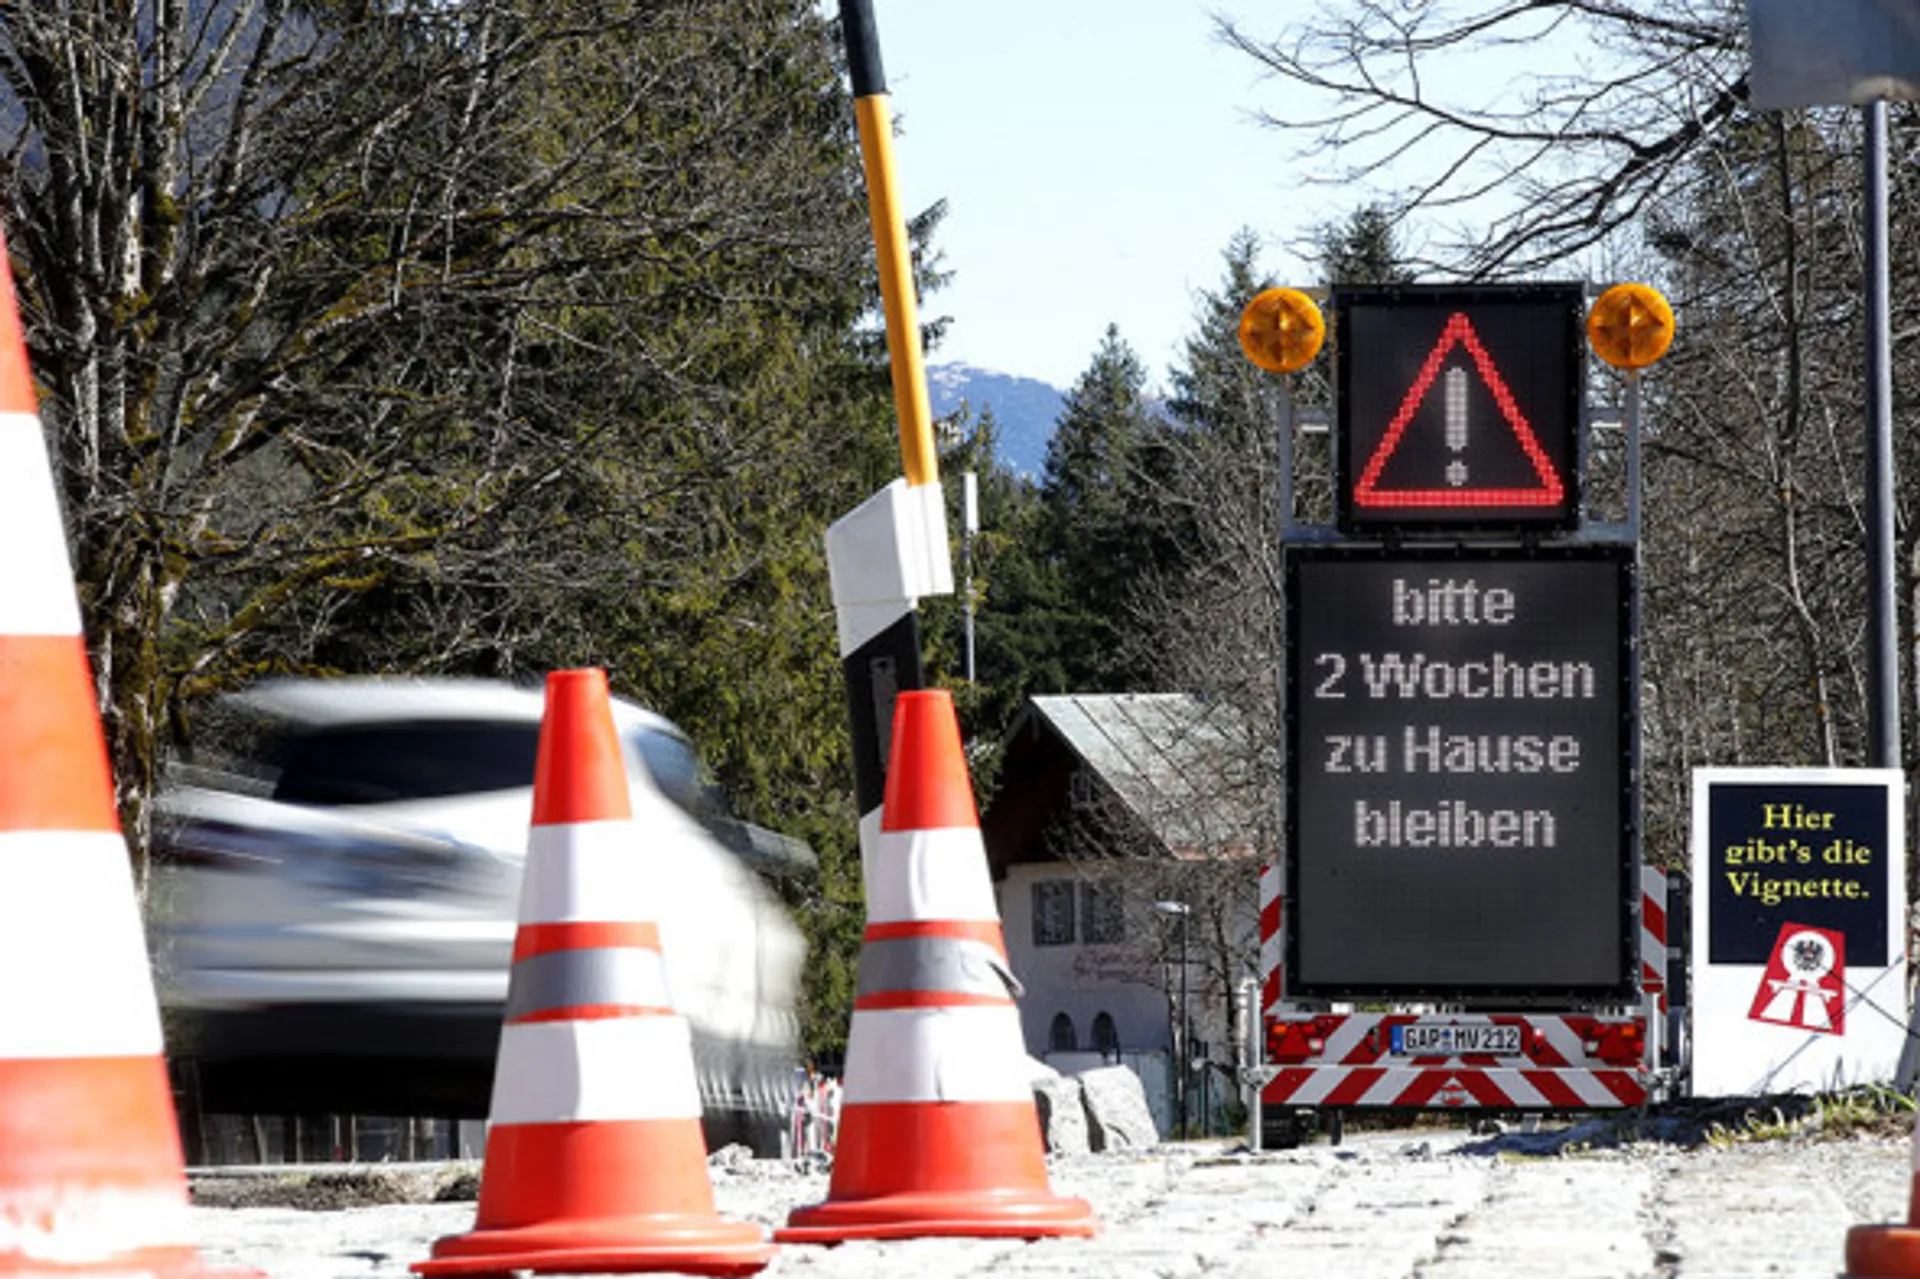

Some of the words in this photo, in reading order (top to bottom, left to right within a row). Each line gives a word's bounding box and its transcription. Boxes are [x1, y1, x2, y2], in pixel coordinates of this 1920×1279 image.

[1392, 579, 1515, 626] bitte
[1314, 653, 1347, 698] 2
[1359, 653, 1596, 698] Wochen
[1324, 735, 1388, 773] zu
[1404, 725, 1580, 773] Hause
[1355, 801, 1556, 847] bleiben
[1762, 803, 1835, 830] Hier
[1724, 839, 1812, 864] gibt's
[1822, 840, 1872, 864] die
[1725, 872, 1870, 906] Vignette.
[1405, 1028, 1440, 1049] GAP
